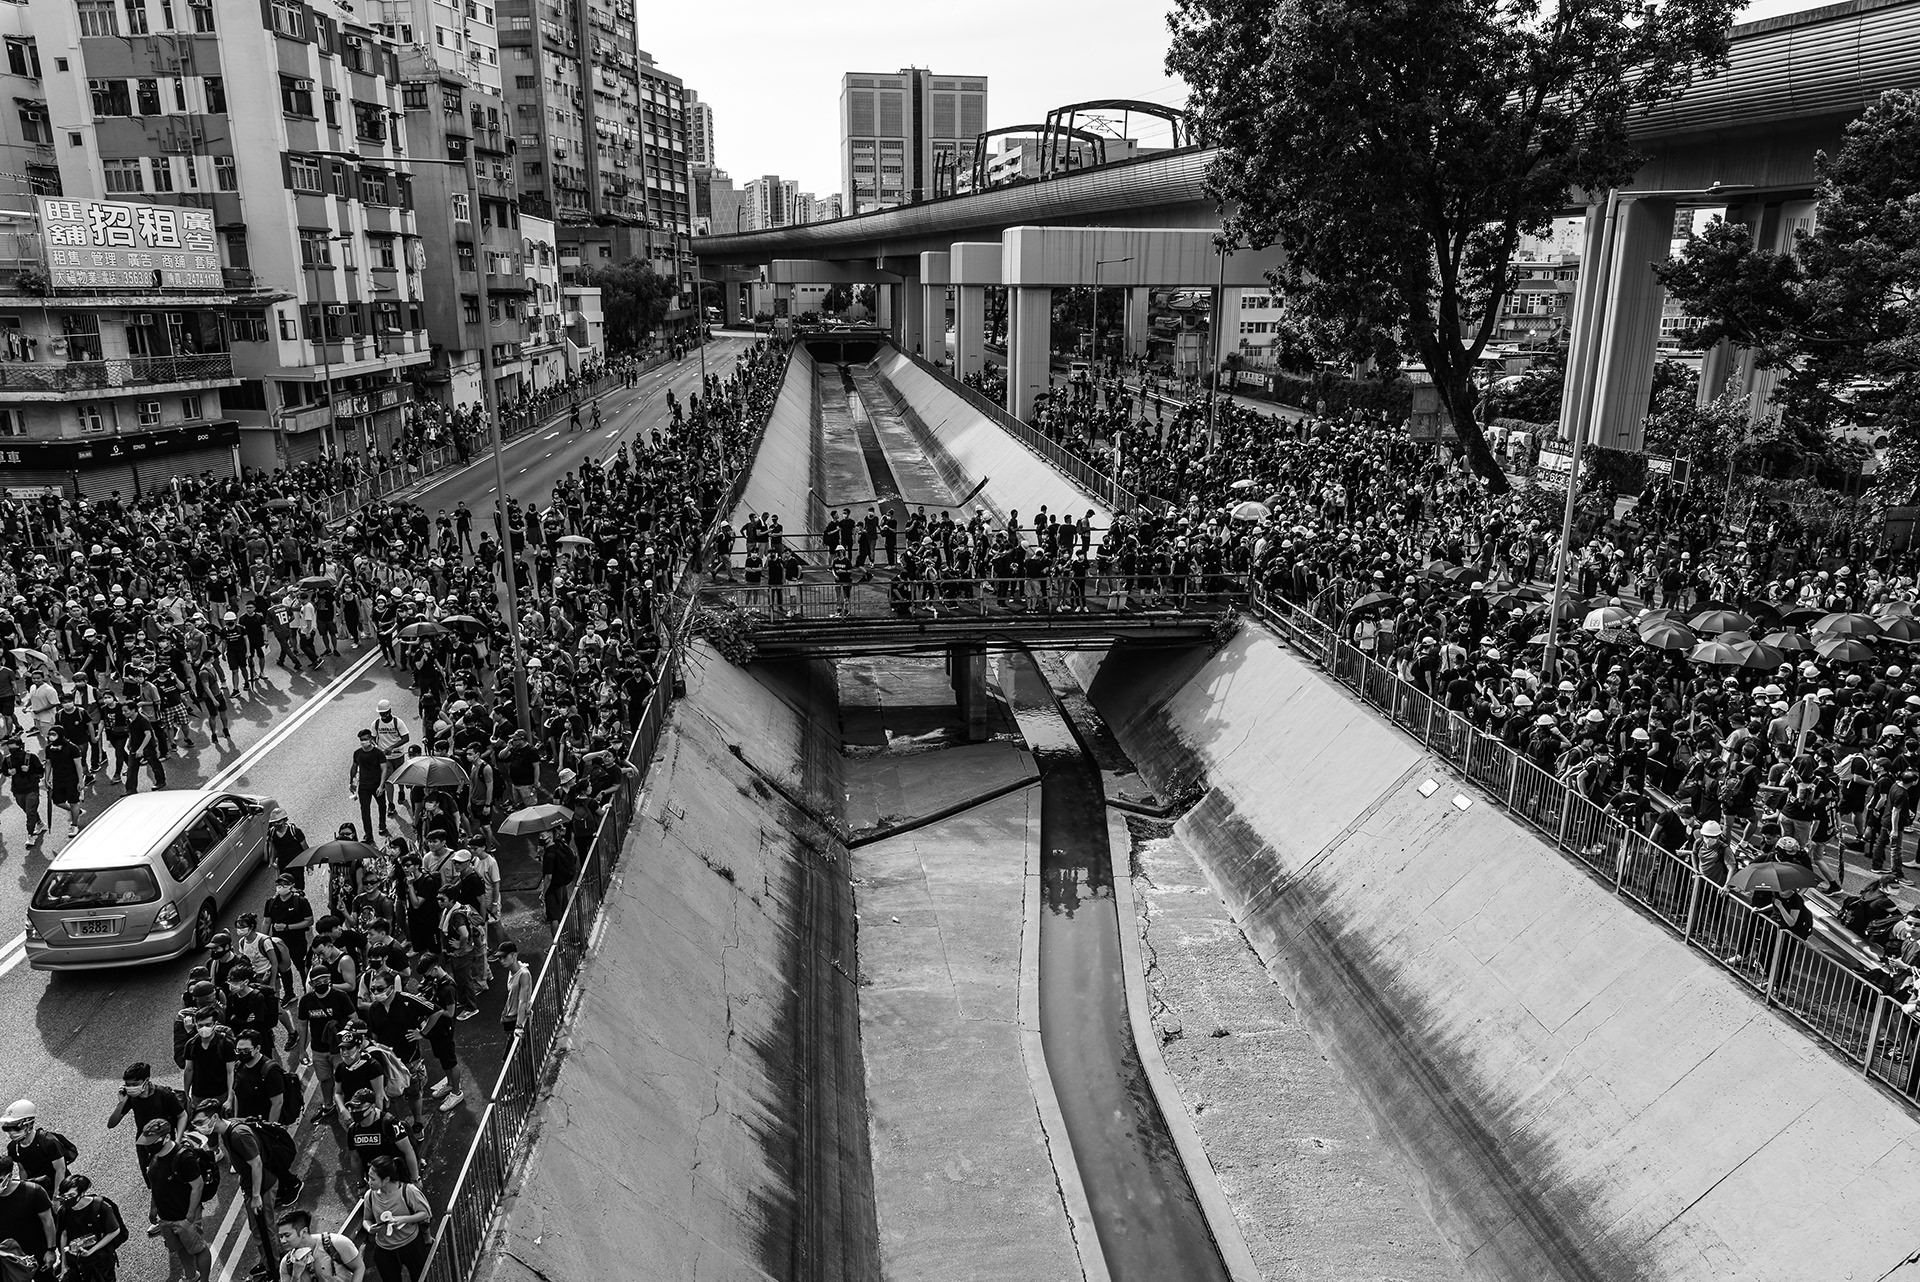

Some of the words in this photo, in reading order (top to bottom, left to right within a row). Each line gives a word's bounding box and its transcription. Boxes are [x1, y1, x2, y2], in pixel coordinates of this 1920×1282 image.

[44, 200, 87, 246] 旺舖
[88, 203, 181, 248] 招租
[182, 211, 214, 252] 廣告
[55, 269, 98, 285] 大福物業
[275, 611, 289, 625] 18
[82, 925, 108, 934] 5202
